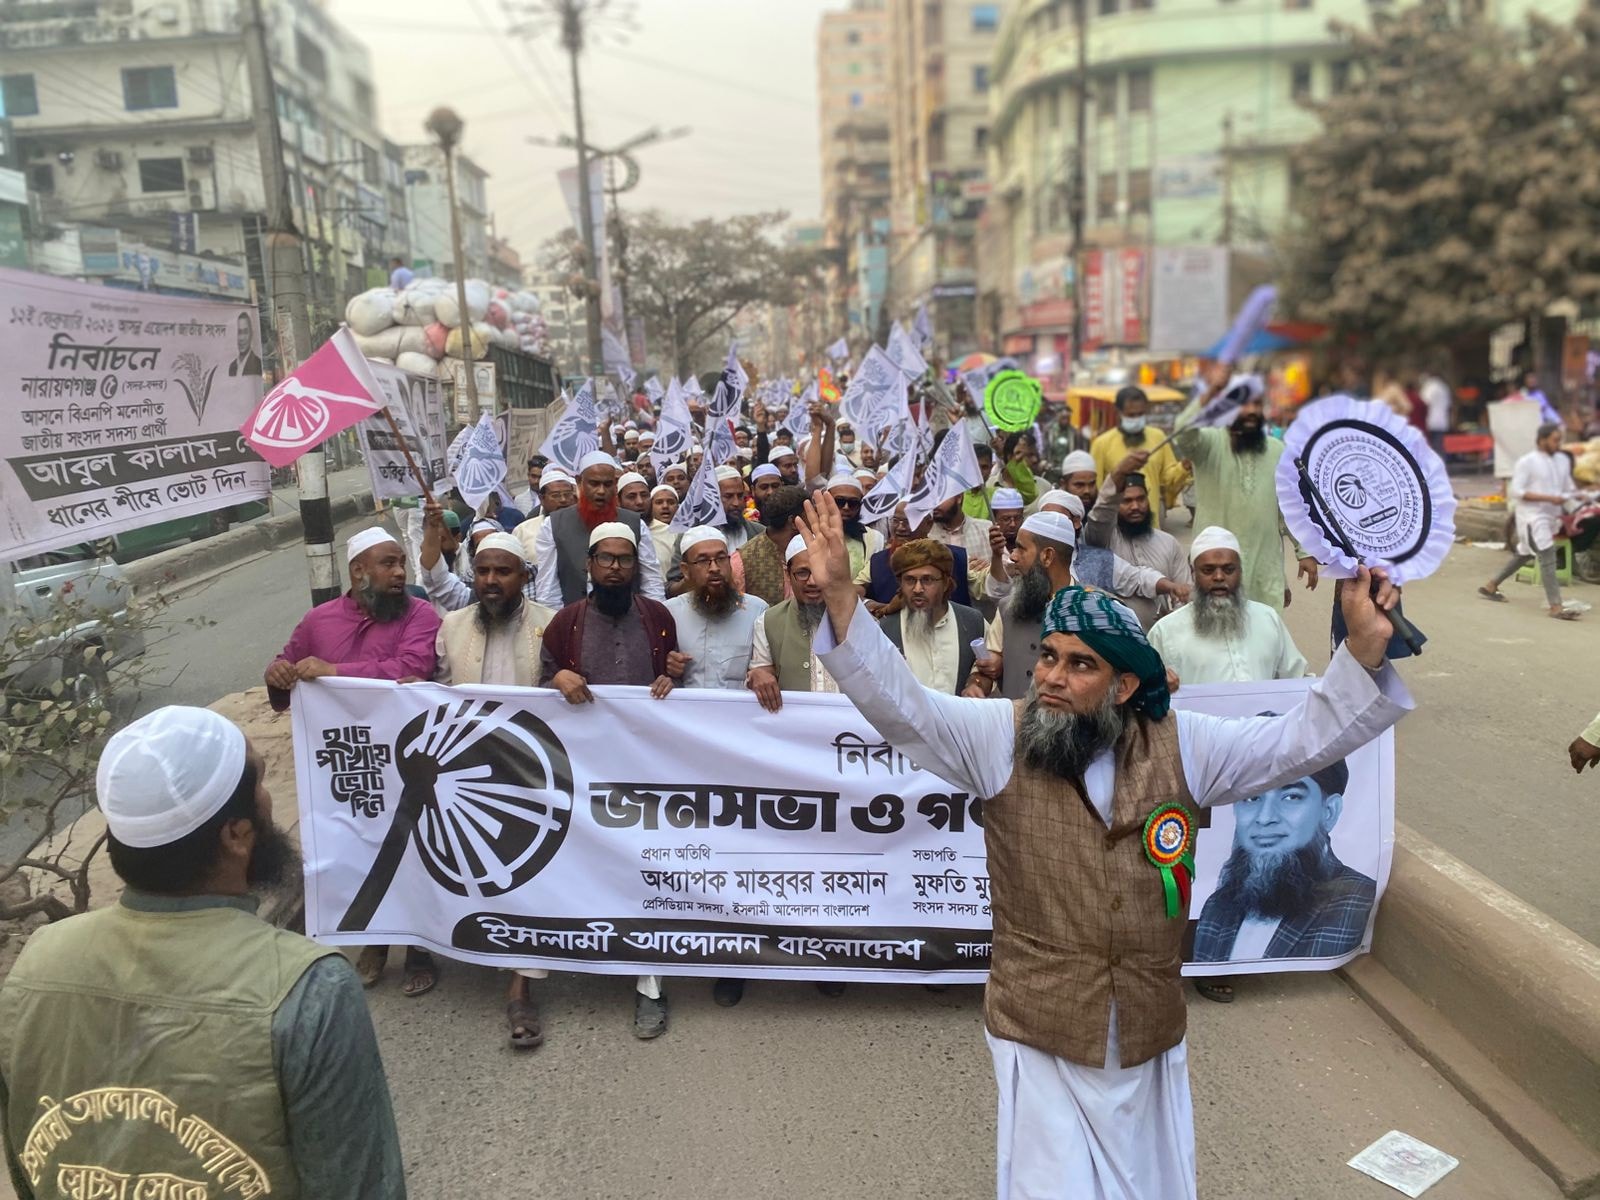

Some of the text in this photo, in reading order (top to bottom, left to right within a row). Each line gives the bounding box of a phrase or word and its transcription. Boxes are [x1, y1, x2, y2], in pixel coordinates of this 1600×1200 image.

[48, 332, 161, 371] নির্বাচনে
[21, 376, 97, 399] নারায়ণগঞ্জ
[21, 398, 165, 426] আসনে বিএনপি মনোনীত
[21, 428, 63, 451] জাতীয়
[66, 429, 102, 447] সংসদ
[105, 426, 137, 442] সদস্য
[24, 451, 117, 487] আবুল
[47, 498, 113, 529] ধানের
[112, 485, 162, 513] শীষে
[166, 475, 208, 503] ভোট
[213, 468, 246, 493] দিন
[330, 766, 385, 803] ভোট
[350, 789, 386, 819] দিন
[588, 782, 840, 833] জনসভা
[850, 793, 906, 834] ও
[641, 843, 712, 861] প্রধান অতিথি
[912, 846, 957, 863] সভাপতি
[640, 869, 889, 900] অধ্যাপক মাহবুবর রহমান
[912, 868, 968, 899] মুফতি
[642, 896, 694, 912] প্রেসিডিয়াম
[733, 900, 770, 917] ইসলামী
[773, 903, 820, 918] আন্দোলন
[823, 904, 870, 918] বাংলাদেশ
[912, 901, 944, 915] সংসদ
[948, 903, 978, 916] সদস্য
[476, 916, 992, 961] ইসলামী আন্দোলন বাংলাদেশ নারা
[177, 1114, 271, 1200] বাংলাদেশ
